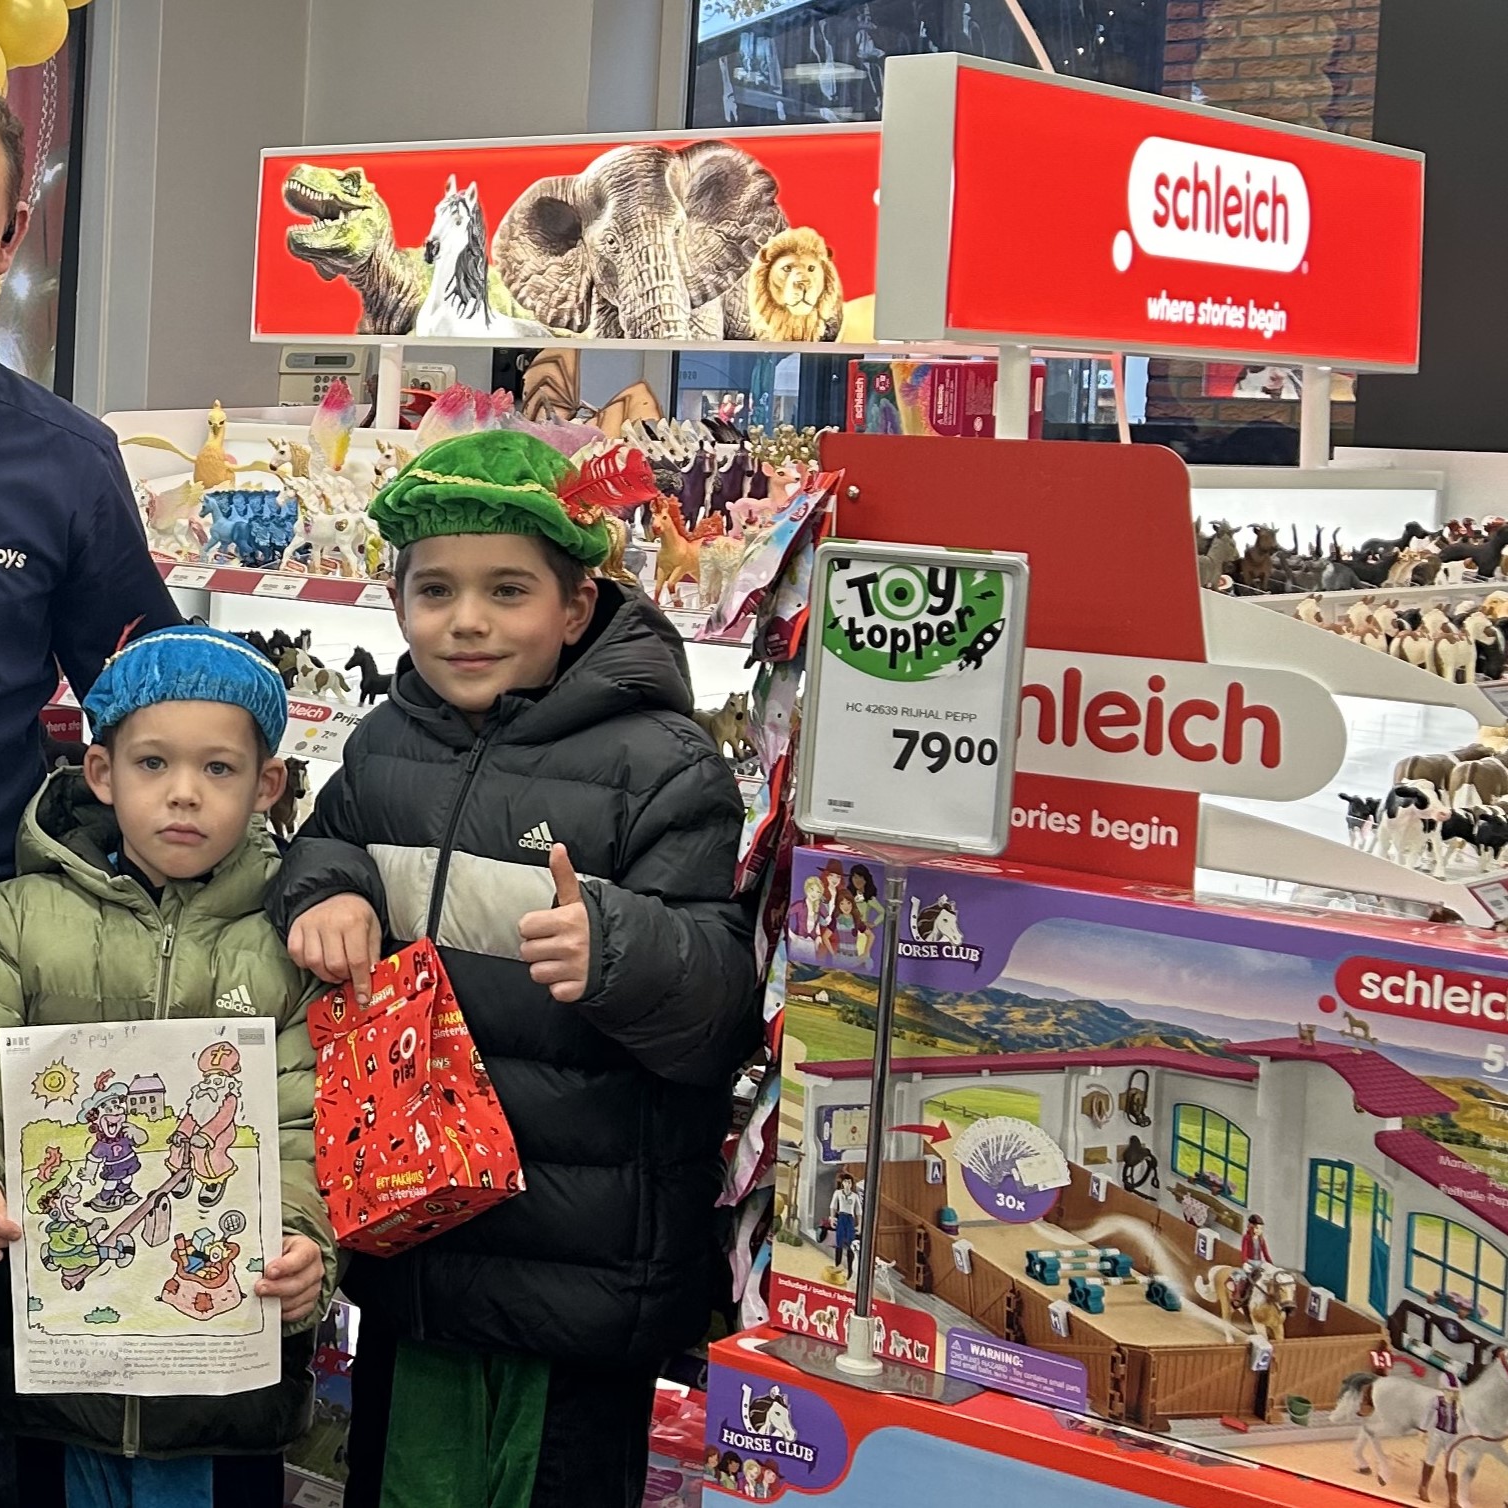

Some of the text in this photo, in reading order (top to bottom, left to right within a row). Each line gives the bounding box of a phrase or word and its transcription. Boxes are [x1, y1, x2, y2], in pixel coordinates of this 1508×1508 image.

[1152, 160, 1289, 245] schleich
[1147, 289, 1287, 339] where stories begin
[844, 604, 977, 670] topper
[288, 702, 362, 727] hleich Prijz
[845, 701, 978, 723] HC 42639 RIJHAL PEPP
[1015, 664, 1283, 770] hleich
[1010, 804, 1179, 851] ories begin
[518, 838, 554, 852] adida
[942, 945, 980, 963] CLUB
[215, 997, 257, 1016] adidas
[1359, 968, 1508, 1022] schleic
[438, 1009, 465, 1024] PAKH
[995, 1192, 1026, 1212] 30x
[969, 1342, 1024, 1368] WARNING:
[722, 1429, 815, 1463] HORSE CLUB
